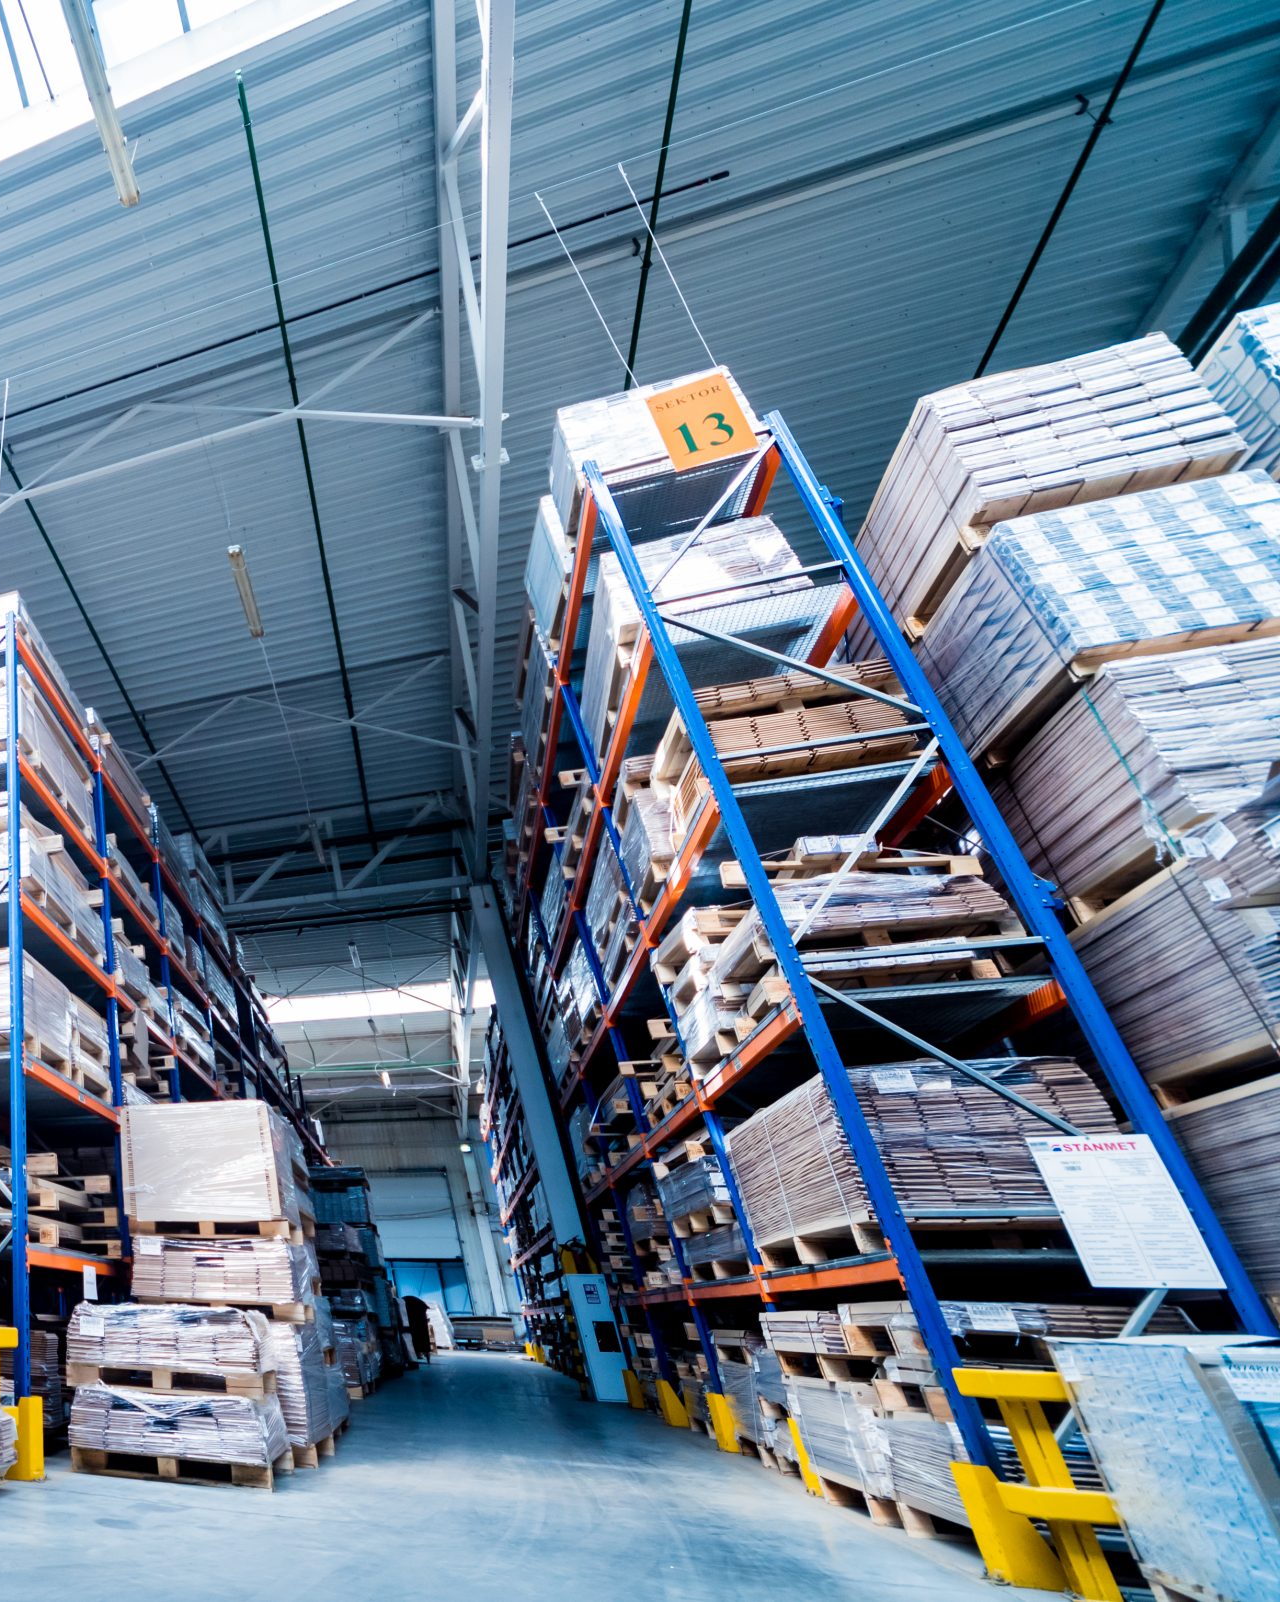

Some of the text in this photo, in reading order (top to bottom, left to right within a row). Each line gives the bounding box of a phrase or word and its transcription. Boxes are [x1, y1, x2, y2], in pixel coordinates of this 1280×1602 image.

[655, 384, 722, 412] SEKTOR
[672, 412, 735, 456] 13
[1062, 1141, 1137, 1153] STANMET
